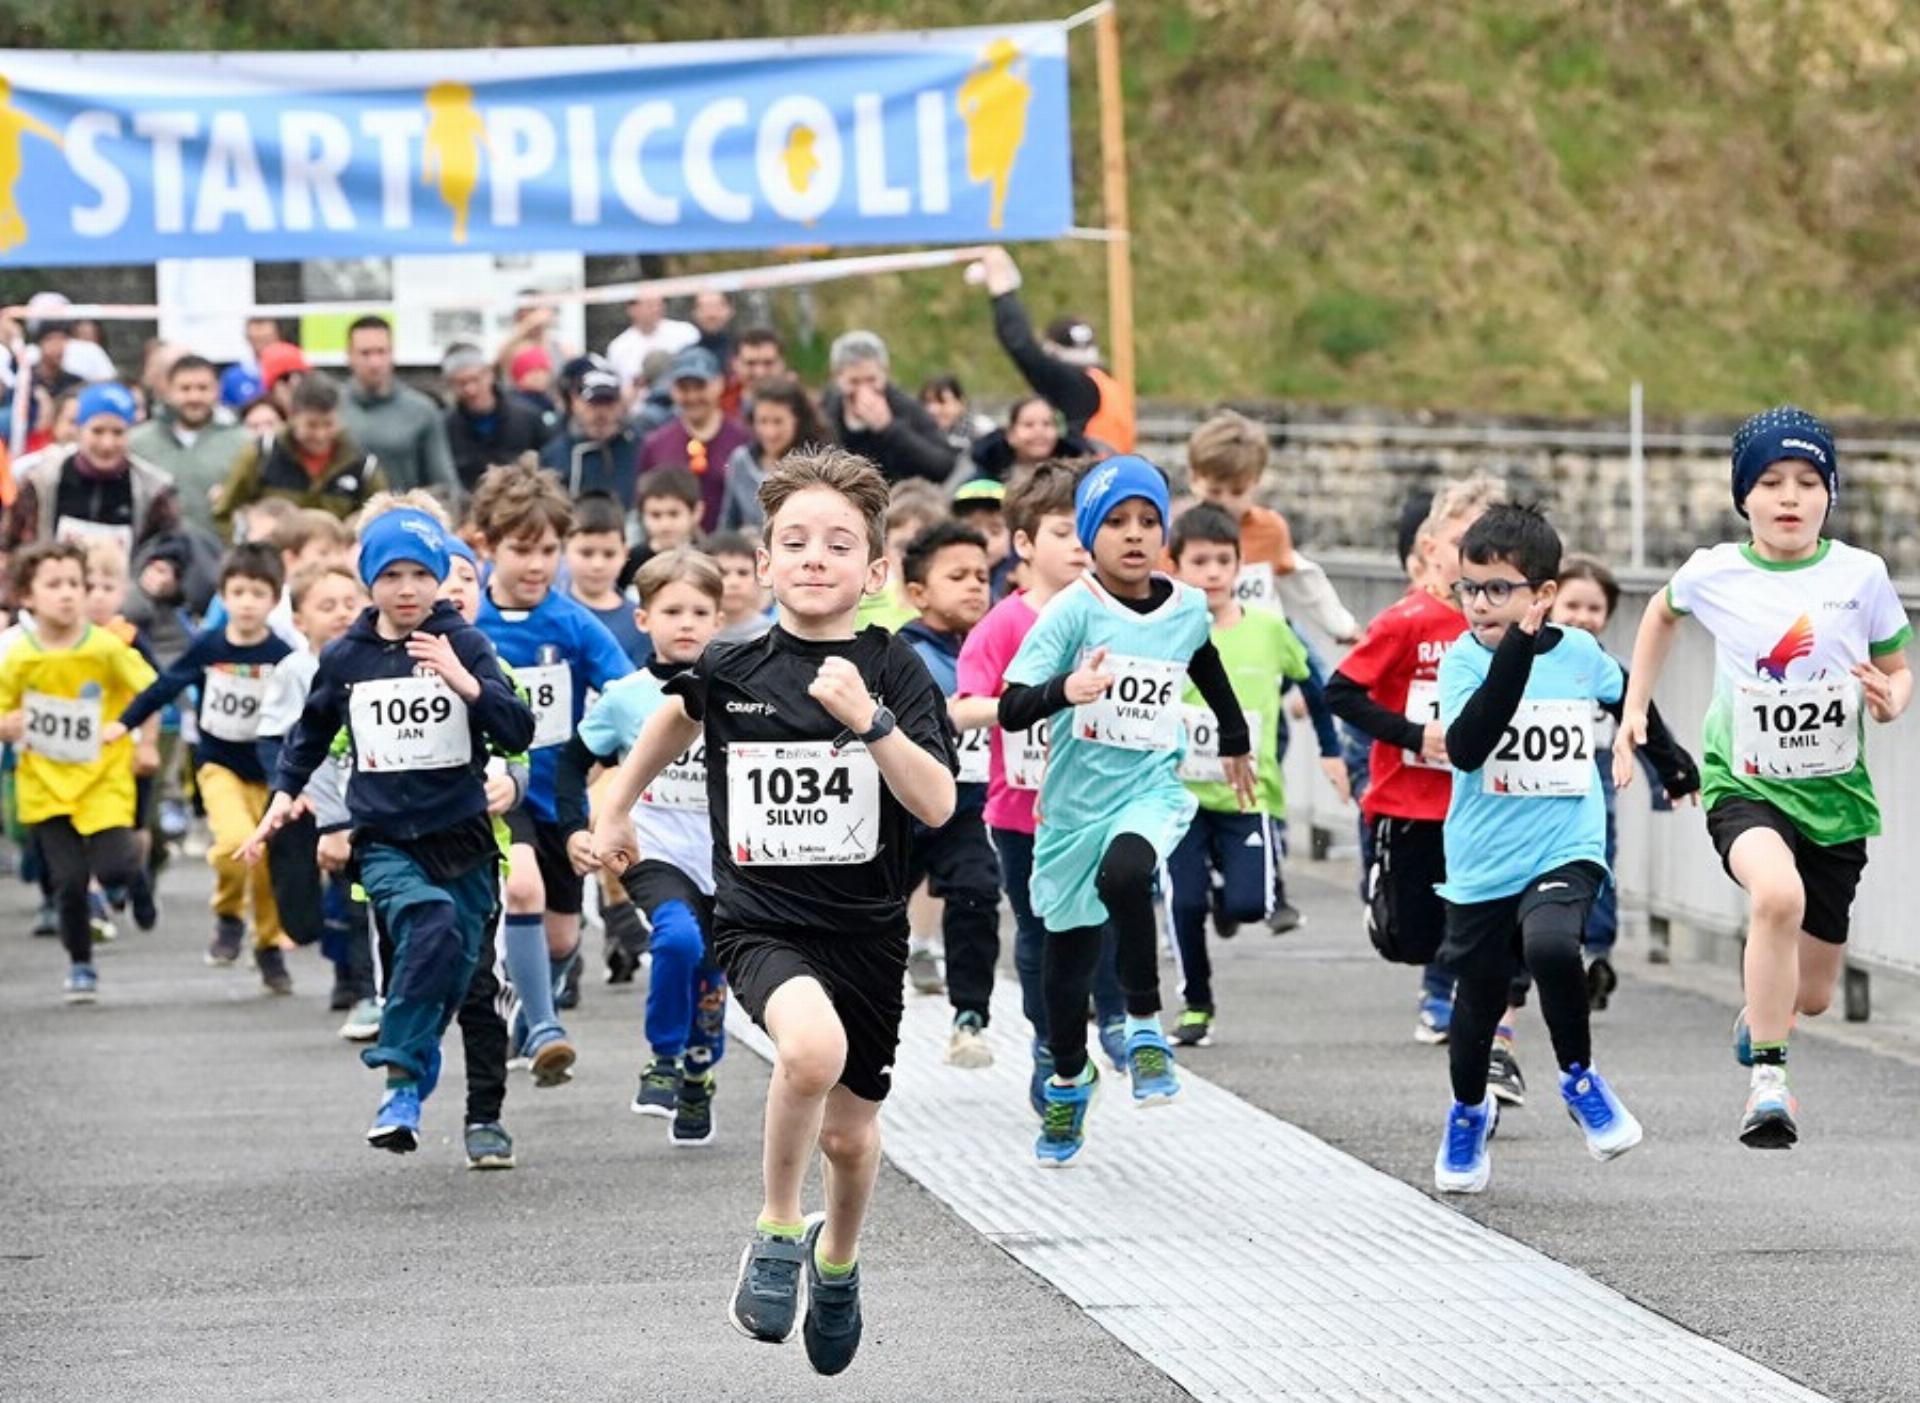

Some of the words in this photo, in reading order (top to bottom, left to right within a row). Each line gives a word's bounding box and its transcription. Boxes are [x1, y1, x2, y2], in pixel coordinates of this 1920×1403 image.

[64, 108, 424, 237] START
[485, 93, 949, 225] PICCOLI
[210, 687, 260, 719] 209
[370, 696, 451, 725] 1069
[725, 700, 766, 714] CRAFT
[1753, 699, 1846, 732] 1024
[29, 707, 91, 741] 2018
[398, 728, 425, 740] JAN
[1495, 725, 1588, 762] 2092
[1779, 734, 1820, 749] EMIL
[747, 767, 854, 804] 1034
[766, 809, 828, 825] SILVIO
